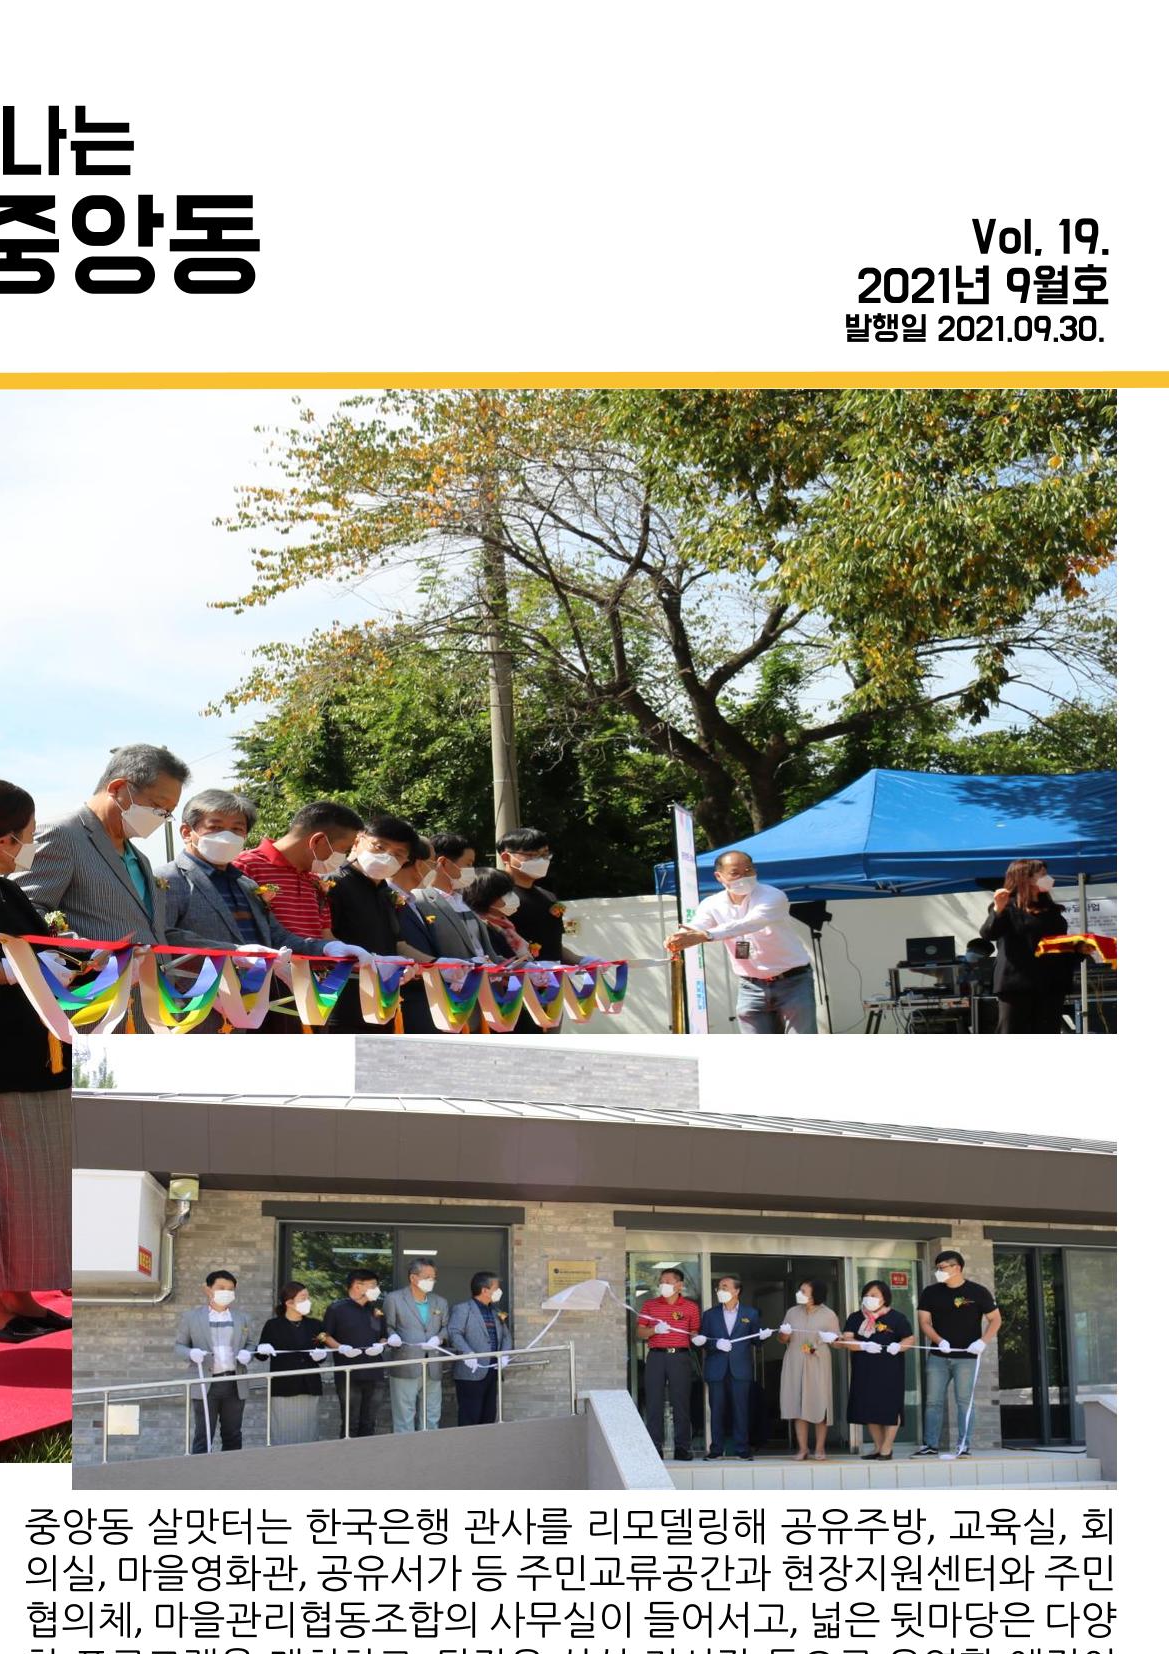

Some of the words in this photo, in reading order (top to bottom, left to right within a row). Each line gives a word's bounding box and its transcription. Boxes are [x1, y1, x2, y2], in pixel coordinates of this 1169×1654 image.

[1059, 218, 1108, 255] 19.
[858, 265, 989, 304] 2021년
[1007, 264, 1108, 304] 9월호
[846, 313, 926, 342] 발행일
[938, 316, 1104, 342] 2021.09.30.
[25, 1508, 133, 1545] 중앙동
[148, 1508, 291, 1545] 살맛터는
[307, 1508, 447, 1545] 한국은행
[465, 1508, 572, 1545] 관사를
[590, 1508, 764, 1545] 리모델링해
[781, 1508, 934, 1545] 공유주방,
[950, 1508, 1066, 1545] 교육실,
[1082, 1508, 1112, 1545] 회
